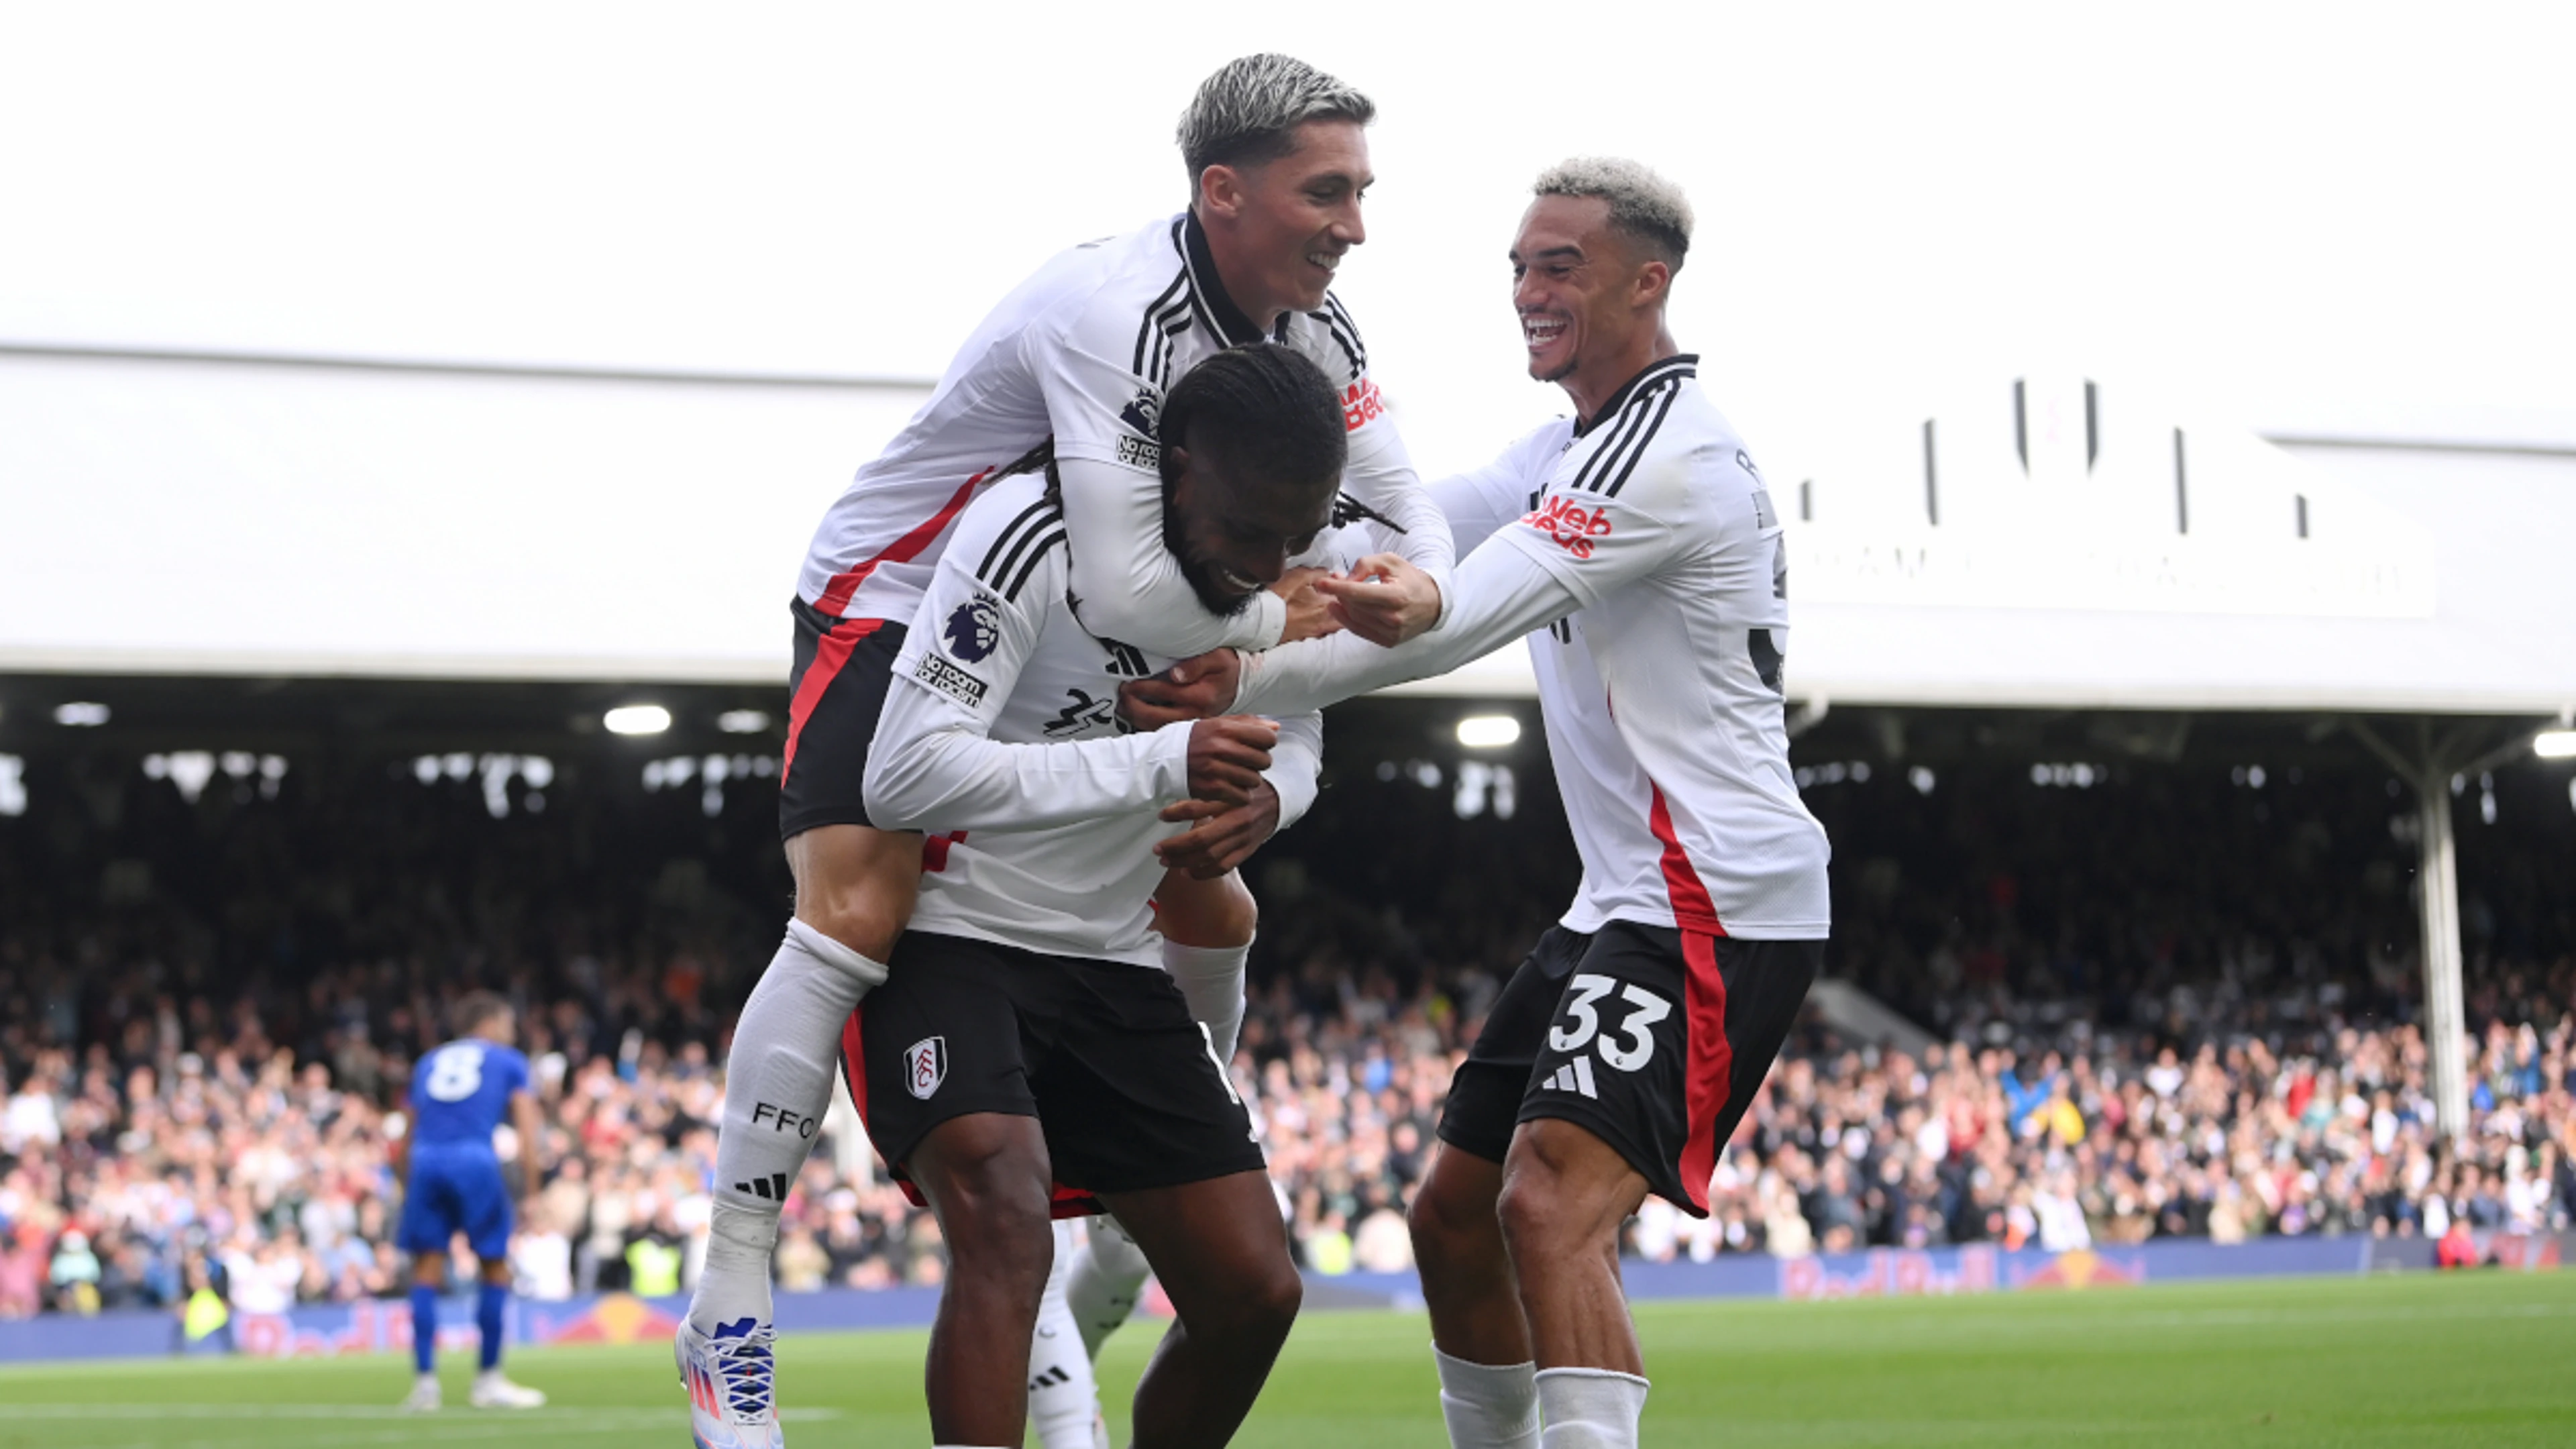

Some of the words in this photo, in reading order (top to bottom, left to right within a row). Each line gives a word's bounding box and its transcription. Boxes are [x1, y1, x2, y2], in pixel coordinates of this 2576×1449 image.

[1117, 434, 1138, 453] No
[1139, 443, 1160, 457] roo
[1543, 495, 1613, 535] Web
[920, 651, 941, 672] No
[942, 665, 980, 695] room
[934, 676, 980, 708] racism
[1550, 974, 1672, 1071] 33
[425, 1039, 485, 1101] 8
[753, 1102, 814, 1139] FFC
